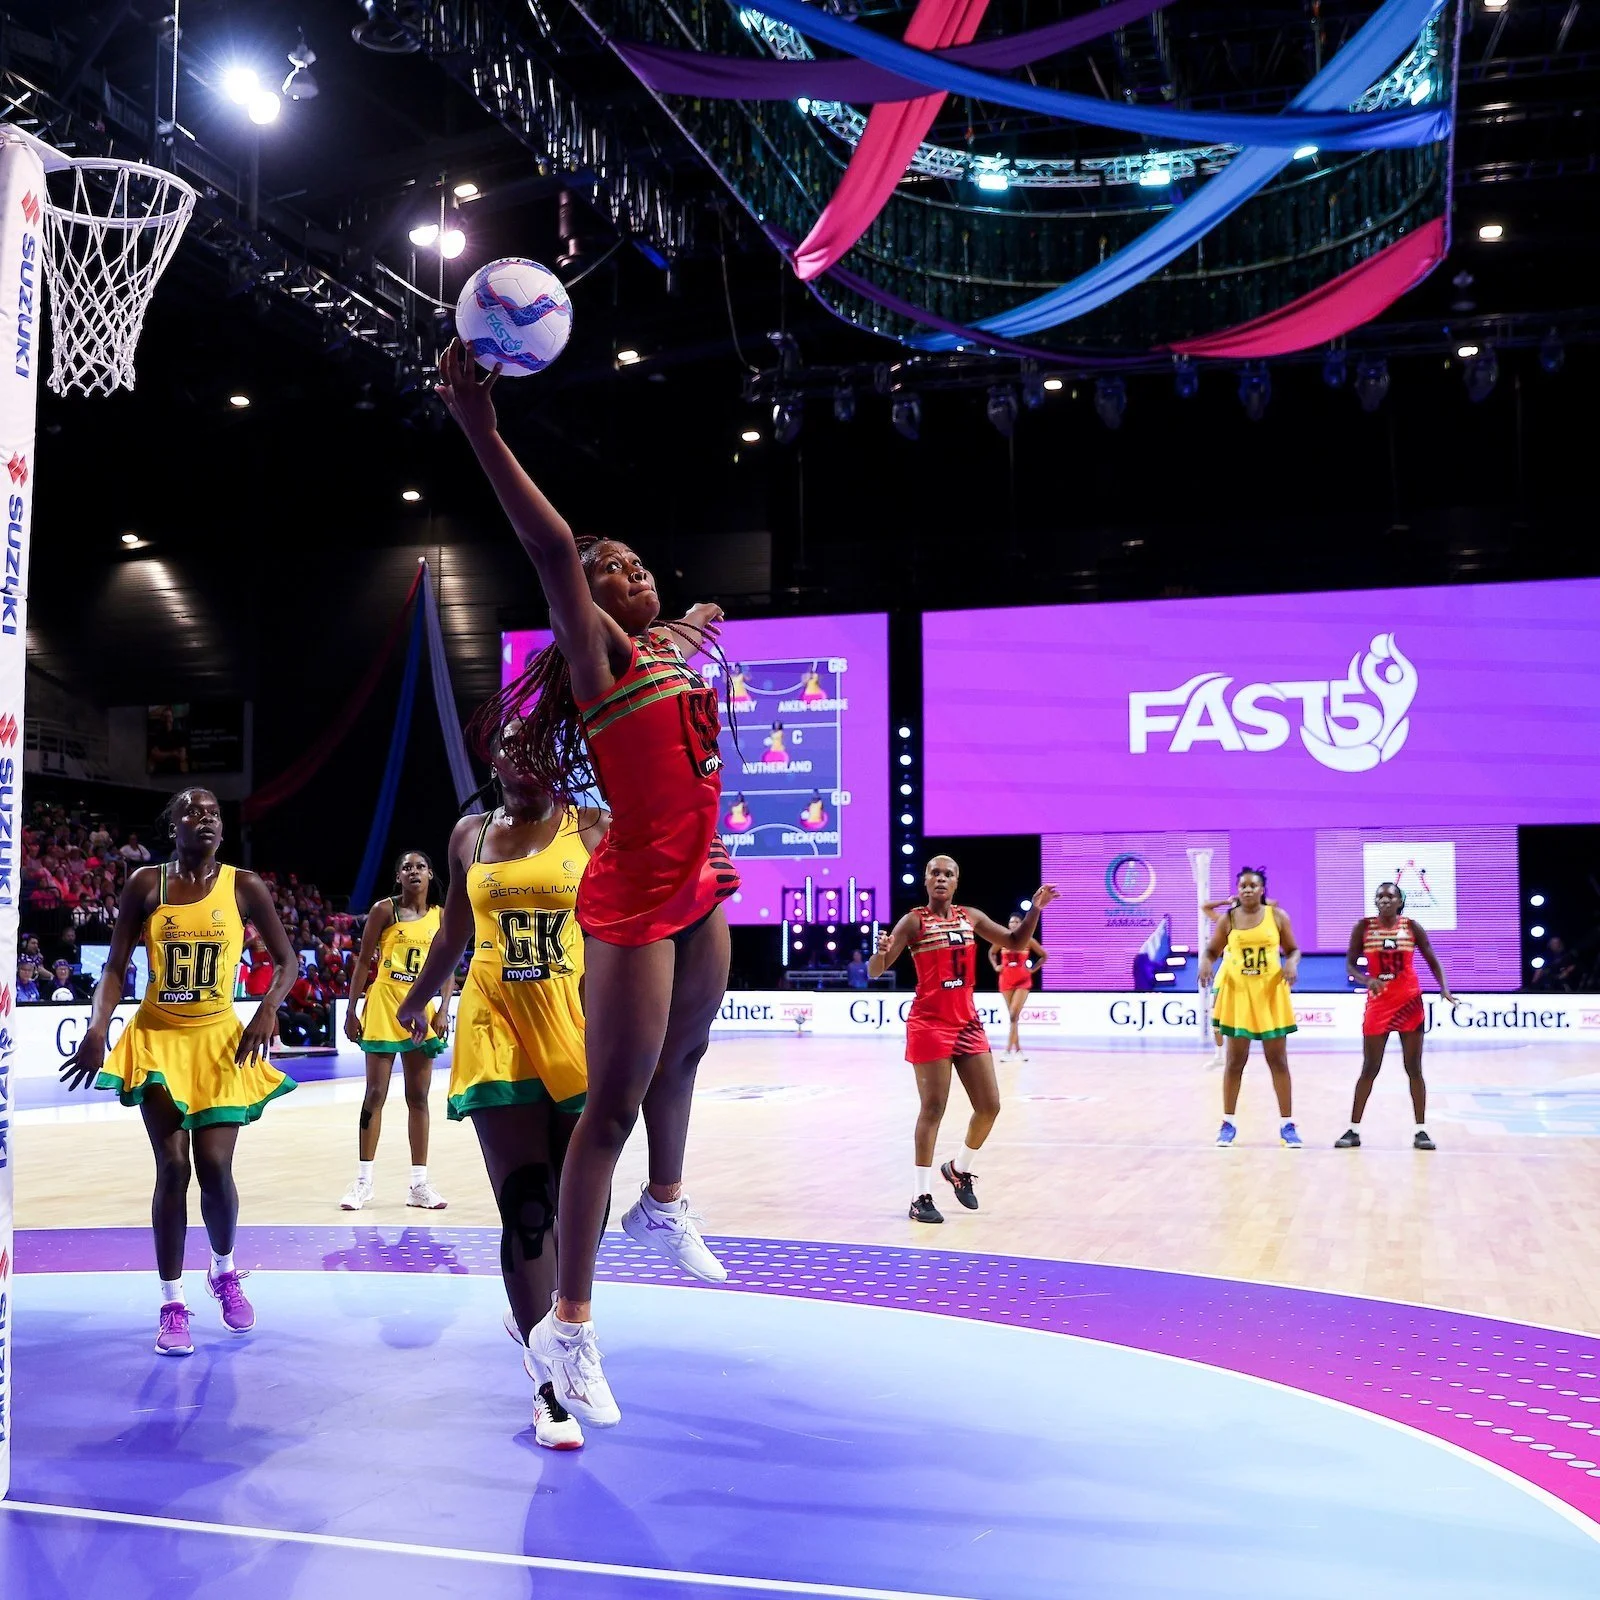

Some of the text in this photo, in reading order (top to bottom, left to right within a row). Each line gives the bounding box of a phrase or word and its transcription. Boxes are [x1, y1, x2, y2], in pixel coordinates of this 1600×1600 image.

[16, 232, 36, 379] SUZUKI
[0, 494, 24, 636] SUZUKI
[792, 730, 803, 744] C
[489, 885, 577, 899] BERYLLIUM
[164, 930, 225, 939] BERYLLIUM
[498, 910, 571, 965] GK
[164, 941, 221, 990] GD
[1242, 946, 1268, 969] GA
[393, 972, 414, 982] myob
[506, 966, 542, 981] myob
[944, 978, 963, 989] myob
[163, 990, 193, 1003] myob
[850, 1000, 890, 1029] G.J.
[1021, 1010, 1057, 1021] OMES
[1110, 1001, 1153, 1031] G.J.
[1294, 1013, 1332, 1023] OMES
[1451, 1002, 1570, 1029] Gardner.
